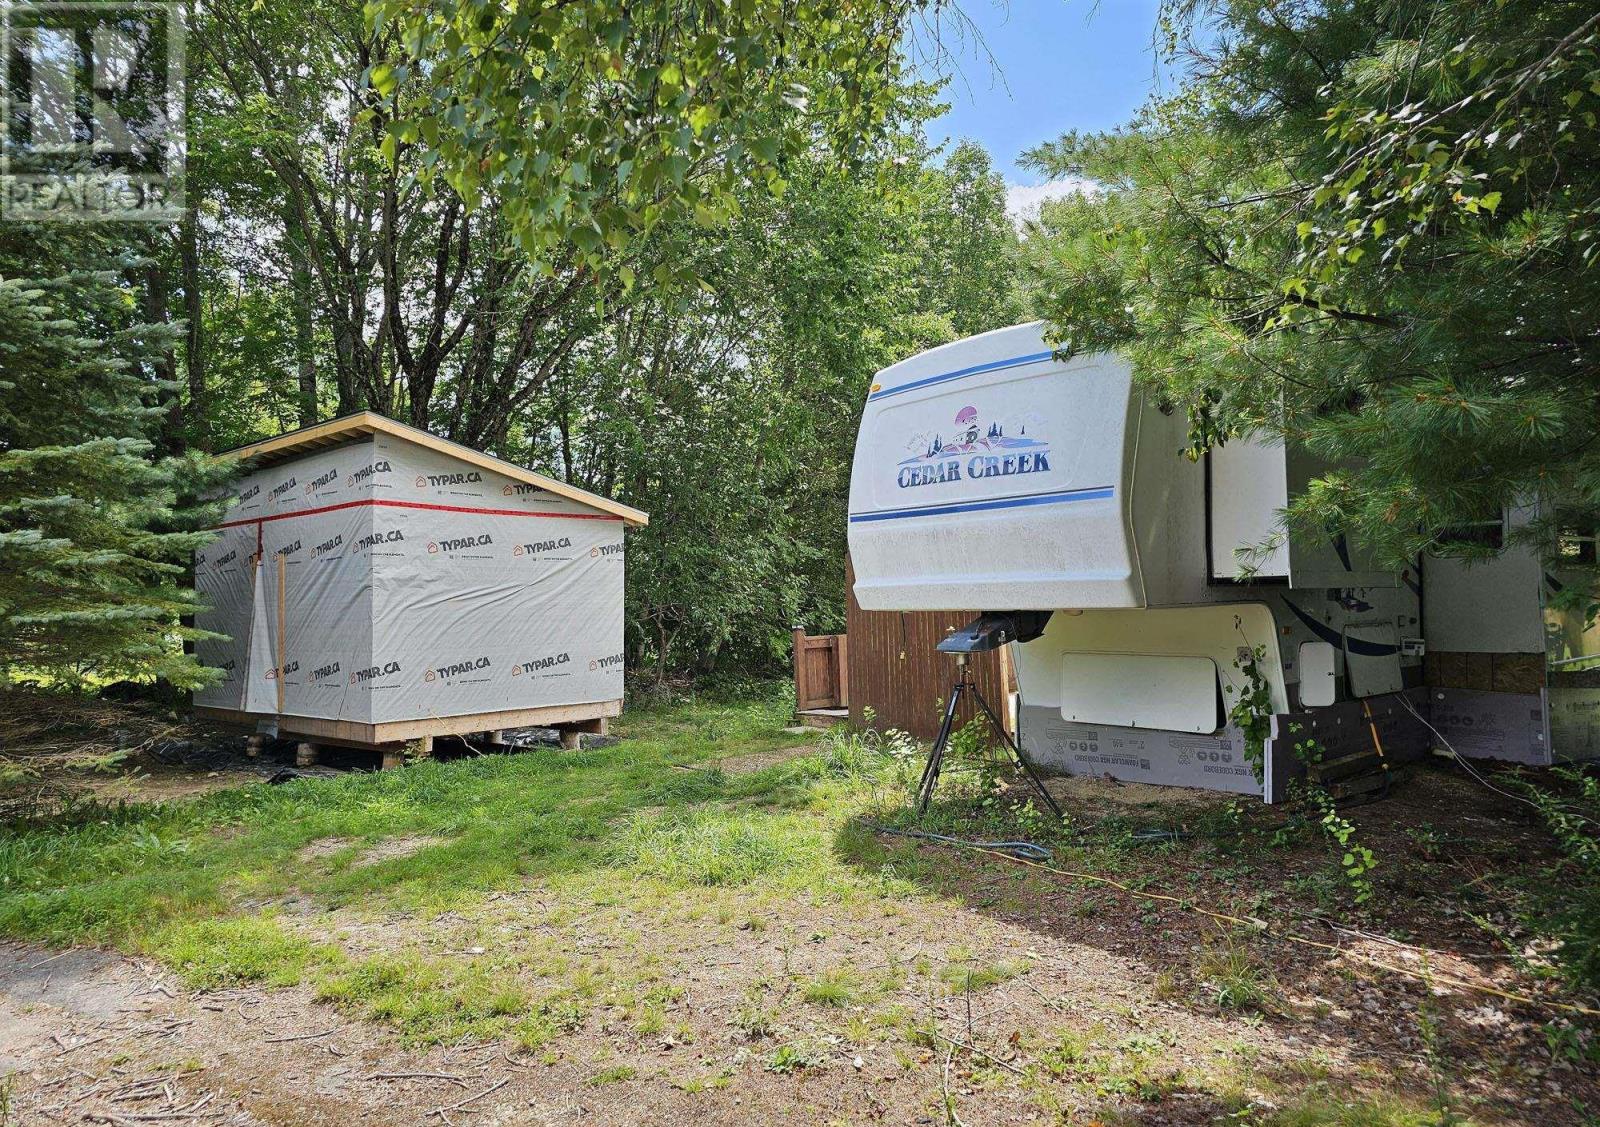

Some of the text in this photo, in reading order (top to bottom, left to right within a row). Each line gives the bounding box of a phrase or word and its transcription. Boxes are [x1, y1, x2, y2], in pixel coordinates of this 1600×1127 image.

[312, 469, 338, 489] TYPAR.CA
[354, 461, 392, 484] TYPAR.CA
[427, 472, 483, 487] TYPAR.CA
[897, 450, 1051, 489] CEDAR CREEK
[273, 477, 297, 498] TYPAR.CA
[316, 534, 343, 556] TYPAR.CA
[358, 530, 404, 551] TYPAR.CA
[439, 534, 493, 552] TYPAR.CA
[523, 537, 572, 555] TYPAR.CA
[313, 661, 341, 681] TYPAR.CA
[436, 656, 491, 679] TYPAR.CA
[522, 652, 570, 674] TYPAR.CA
